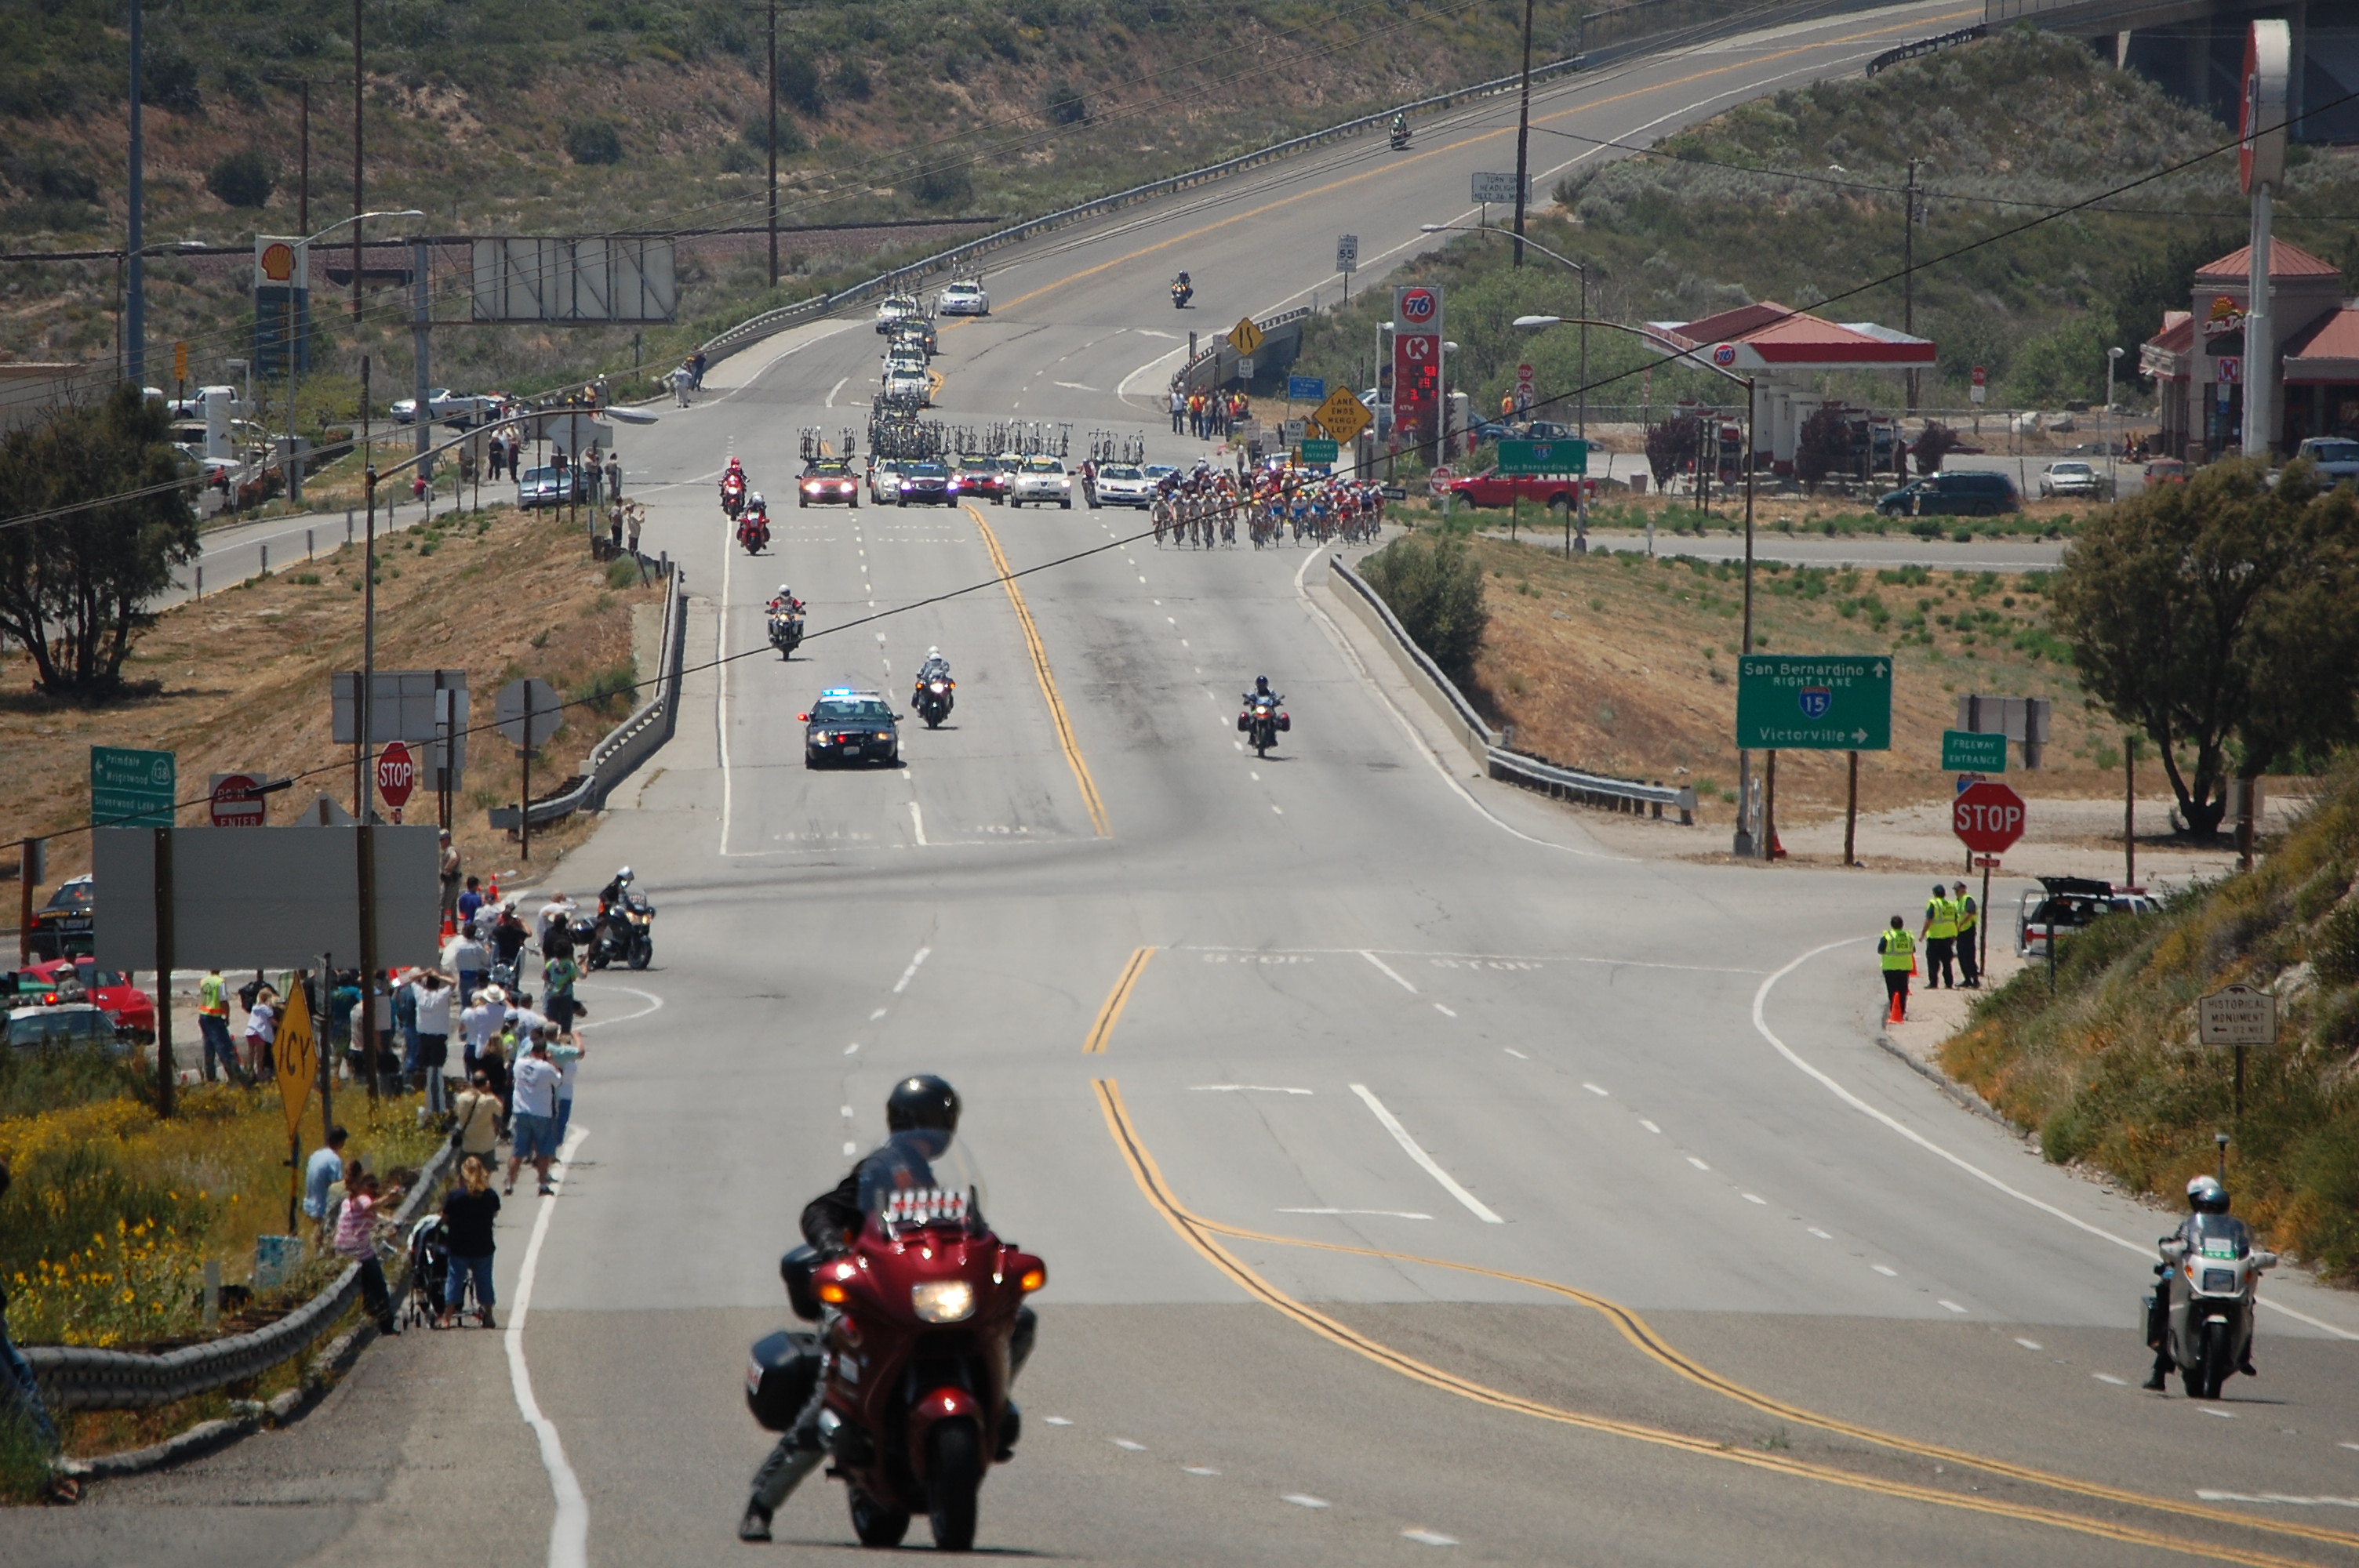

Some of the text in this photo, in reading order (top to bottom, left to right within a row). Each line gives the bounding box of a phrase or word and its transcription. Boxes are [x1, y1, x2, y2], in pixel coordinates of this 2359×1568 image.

[1339, 249, 1354, 259] 55
[1406, 296, 1430, 315] 76
[1717, 348, 1732, 361] 76
[1744, 662, 1865, 677] San Bernardino
[1773, 677, 1852, 687] RIGHT LANE
[1805, 696, 1826, 713] 15
[1759, 727, 1845, 742] Victorville
[1953, 739, 1996, 750] FREEWAY
[106, 755, 140, 767] Palmdale
[1949, 754, 1998, 765] ENTRANCE
[106, 771, 149, 786] Wrightwood
[154, 767, 167, 780] 138
[380, 762, 412, 787] STOP
[217, 789, 232, 800] DO
[95, 796, 154, 811] Silverwood Lake
[220, 816, 256, 827] ENTER
[1957, 804, 2021, 833] STOP
[1204, 953, 1314, 964] STOP
[1430, 959, 1543, 970] STOP
[2208, 1000, 2266, 1009] HISTORICAL
[2212, 1013, 2265, 1023] MONUMENT
[279, 1029, 310, 1080] ICY
